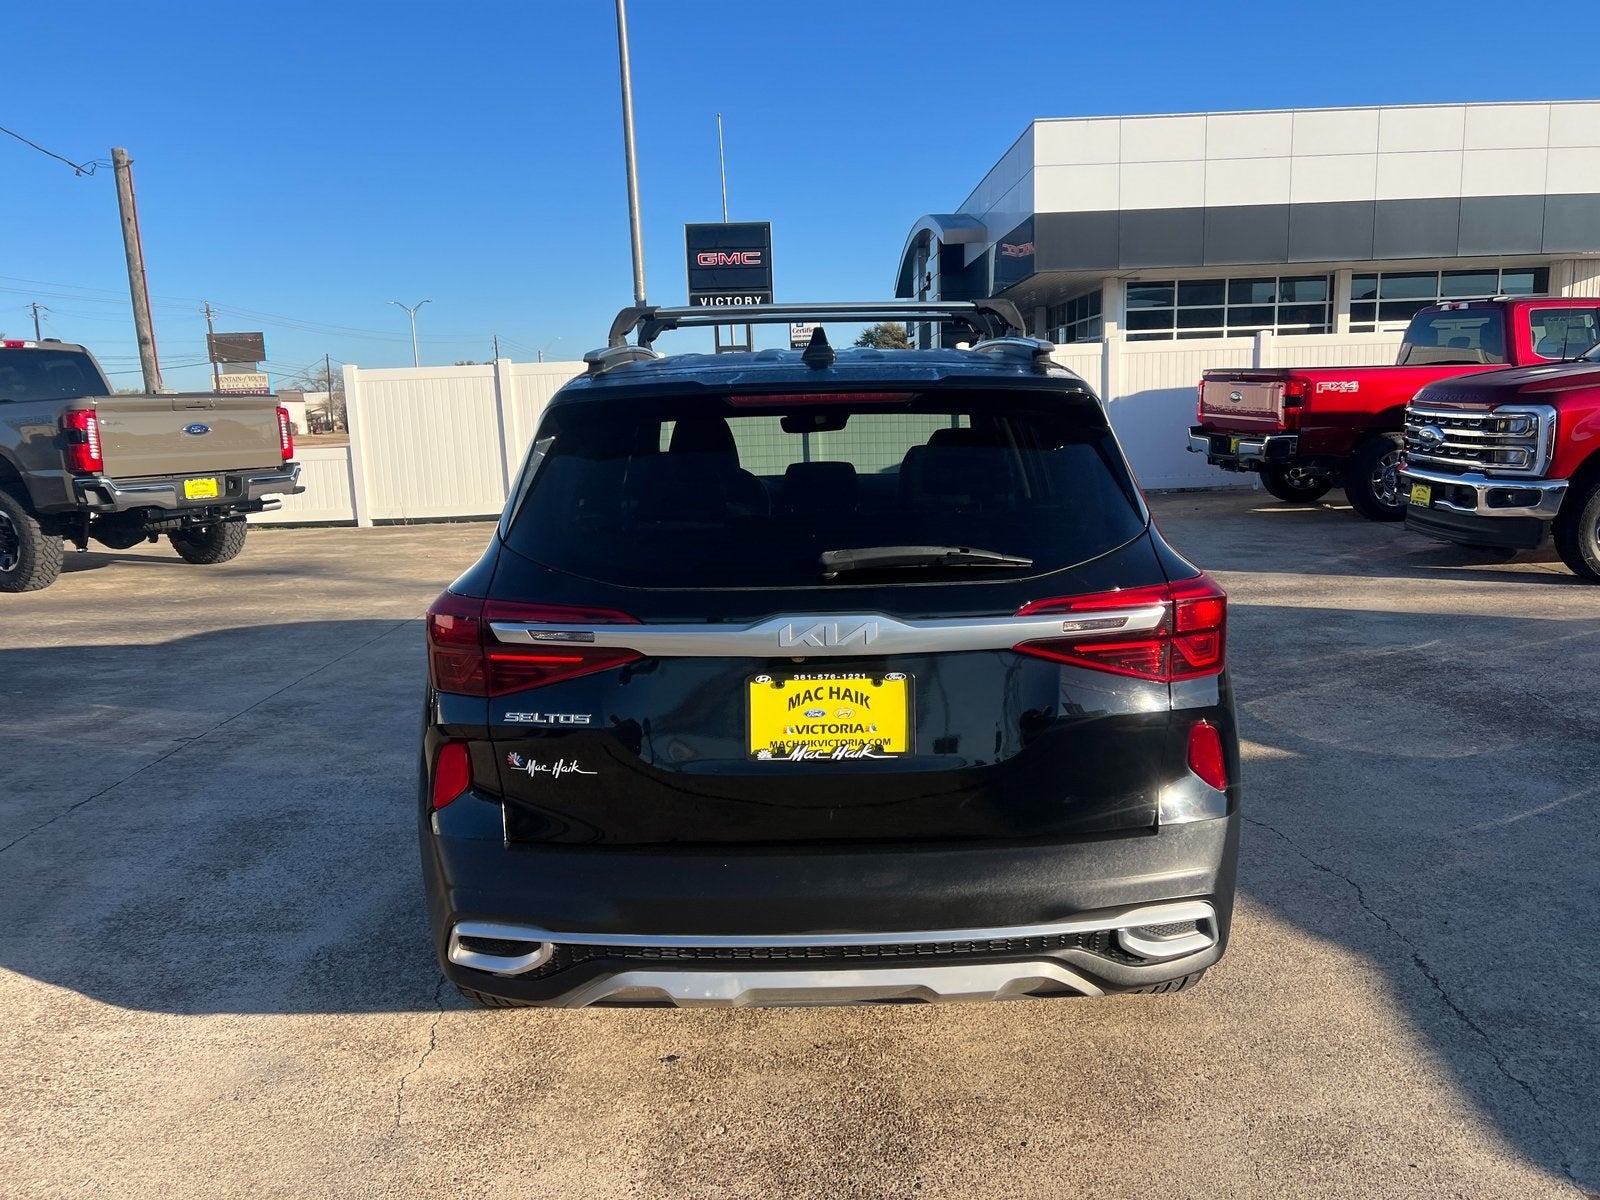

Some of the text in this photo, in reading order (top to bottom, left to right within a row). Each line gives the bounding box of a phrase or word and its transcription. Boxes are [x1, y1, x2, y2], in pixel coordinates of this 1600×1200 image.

[698, 252, 761, 265] GMC
[701, 296, 762, 306] VICTORY
[792, 327, 813, 335] Certifi
[1316, 381, 1359, 394] FX4
[778, 622, 878, 648] KIA
[793, 673, 867, 681] 361-576-1221
[788, 685, 871, 711] MAC HAIK
[503, 712, 592, 725] SELTOS
[805, 709, 826, 718] Ford
[794, 723, 865, 735] VICTORIA
[769, 738, 891, 748] MACHAIKVICTORIA.COM
[788, 744, 898, 761] Mac Haik
[525, 758, 598, 779] Mac Haik
